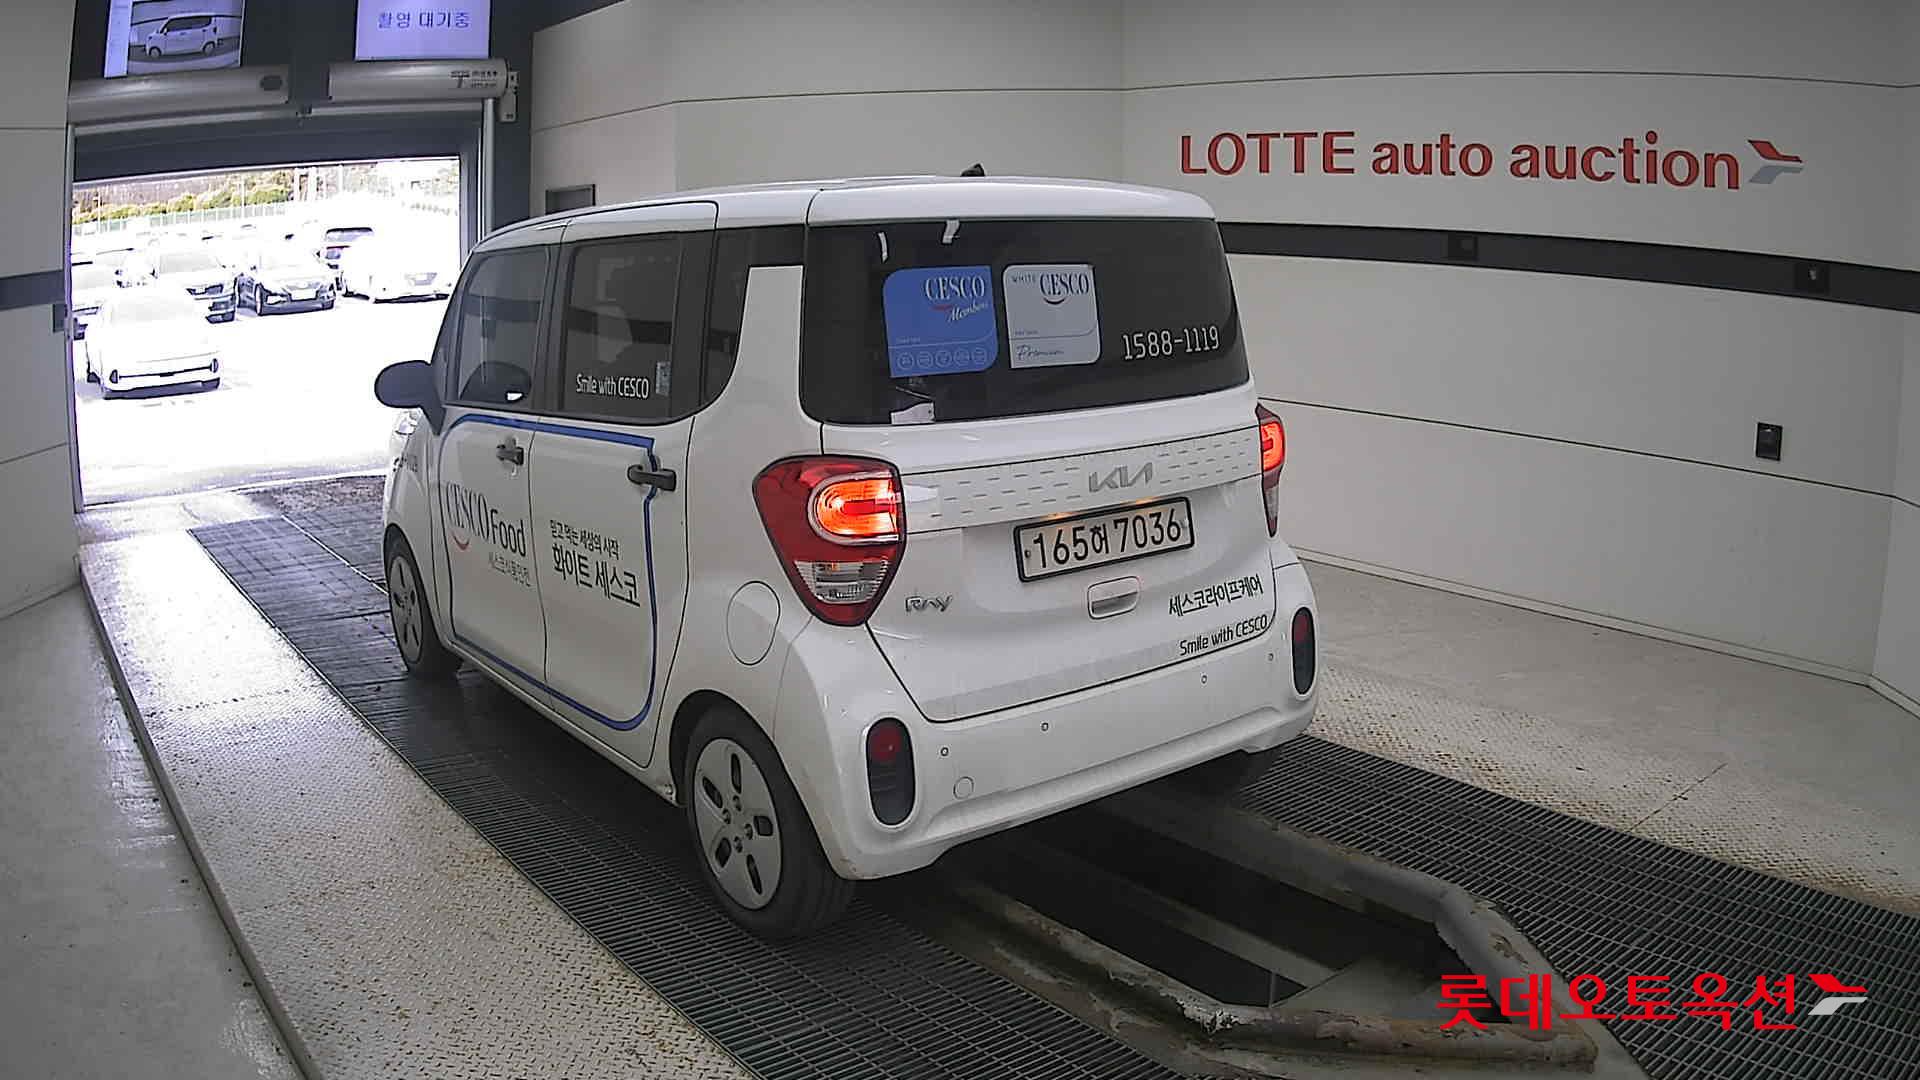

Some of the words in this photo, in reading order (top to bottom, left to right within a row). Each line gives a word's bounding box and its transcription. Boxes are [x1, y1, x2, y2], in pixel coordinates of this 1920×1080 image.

[419, 11, 471, 29] 대기중
[1180, 131, 1356, 176] LOTTE
[1371, 133, 1494, 177] auto
[1510, 130, 1740, 190] auction
[925, 275, 985, 301] CESCO
[1040, 271, 1090, 296] CESCO
[1122, 325, 1220, 360] 1588-1119
[575, 372, 597, 393] Smile
[598, 375, 617, 396] with
[618, 376, 650, 399] CESCO
[445, 482, 490, 541] CESCO
[603, 536, 620, 561] 시작
[551, 542, 593, 587] 화이트
[595, 561, 641, 608] 세스코
[1168, 573, 1264, 617] 세스코라이프케어
[1179, 635, 1209, 656] Smile
[1211, 626, 1234, 646] with
[1235, 614, 1268, 637] CESCO
